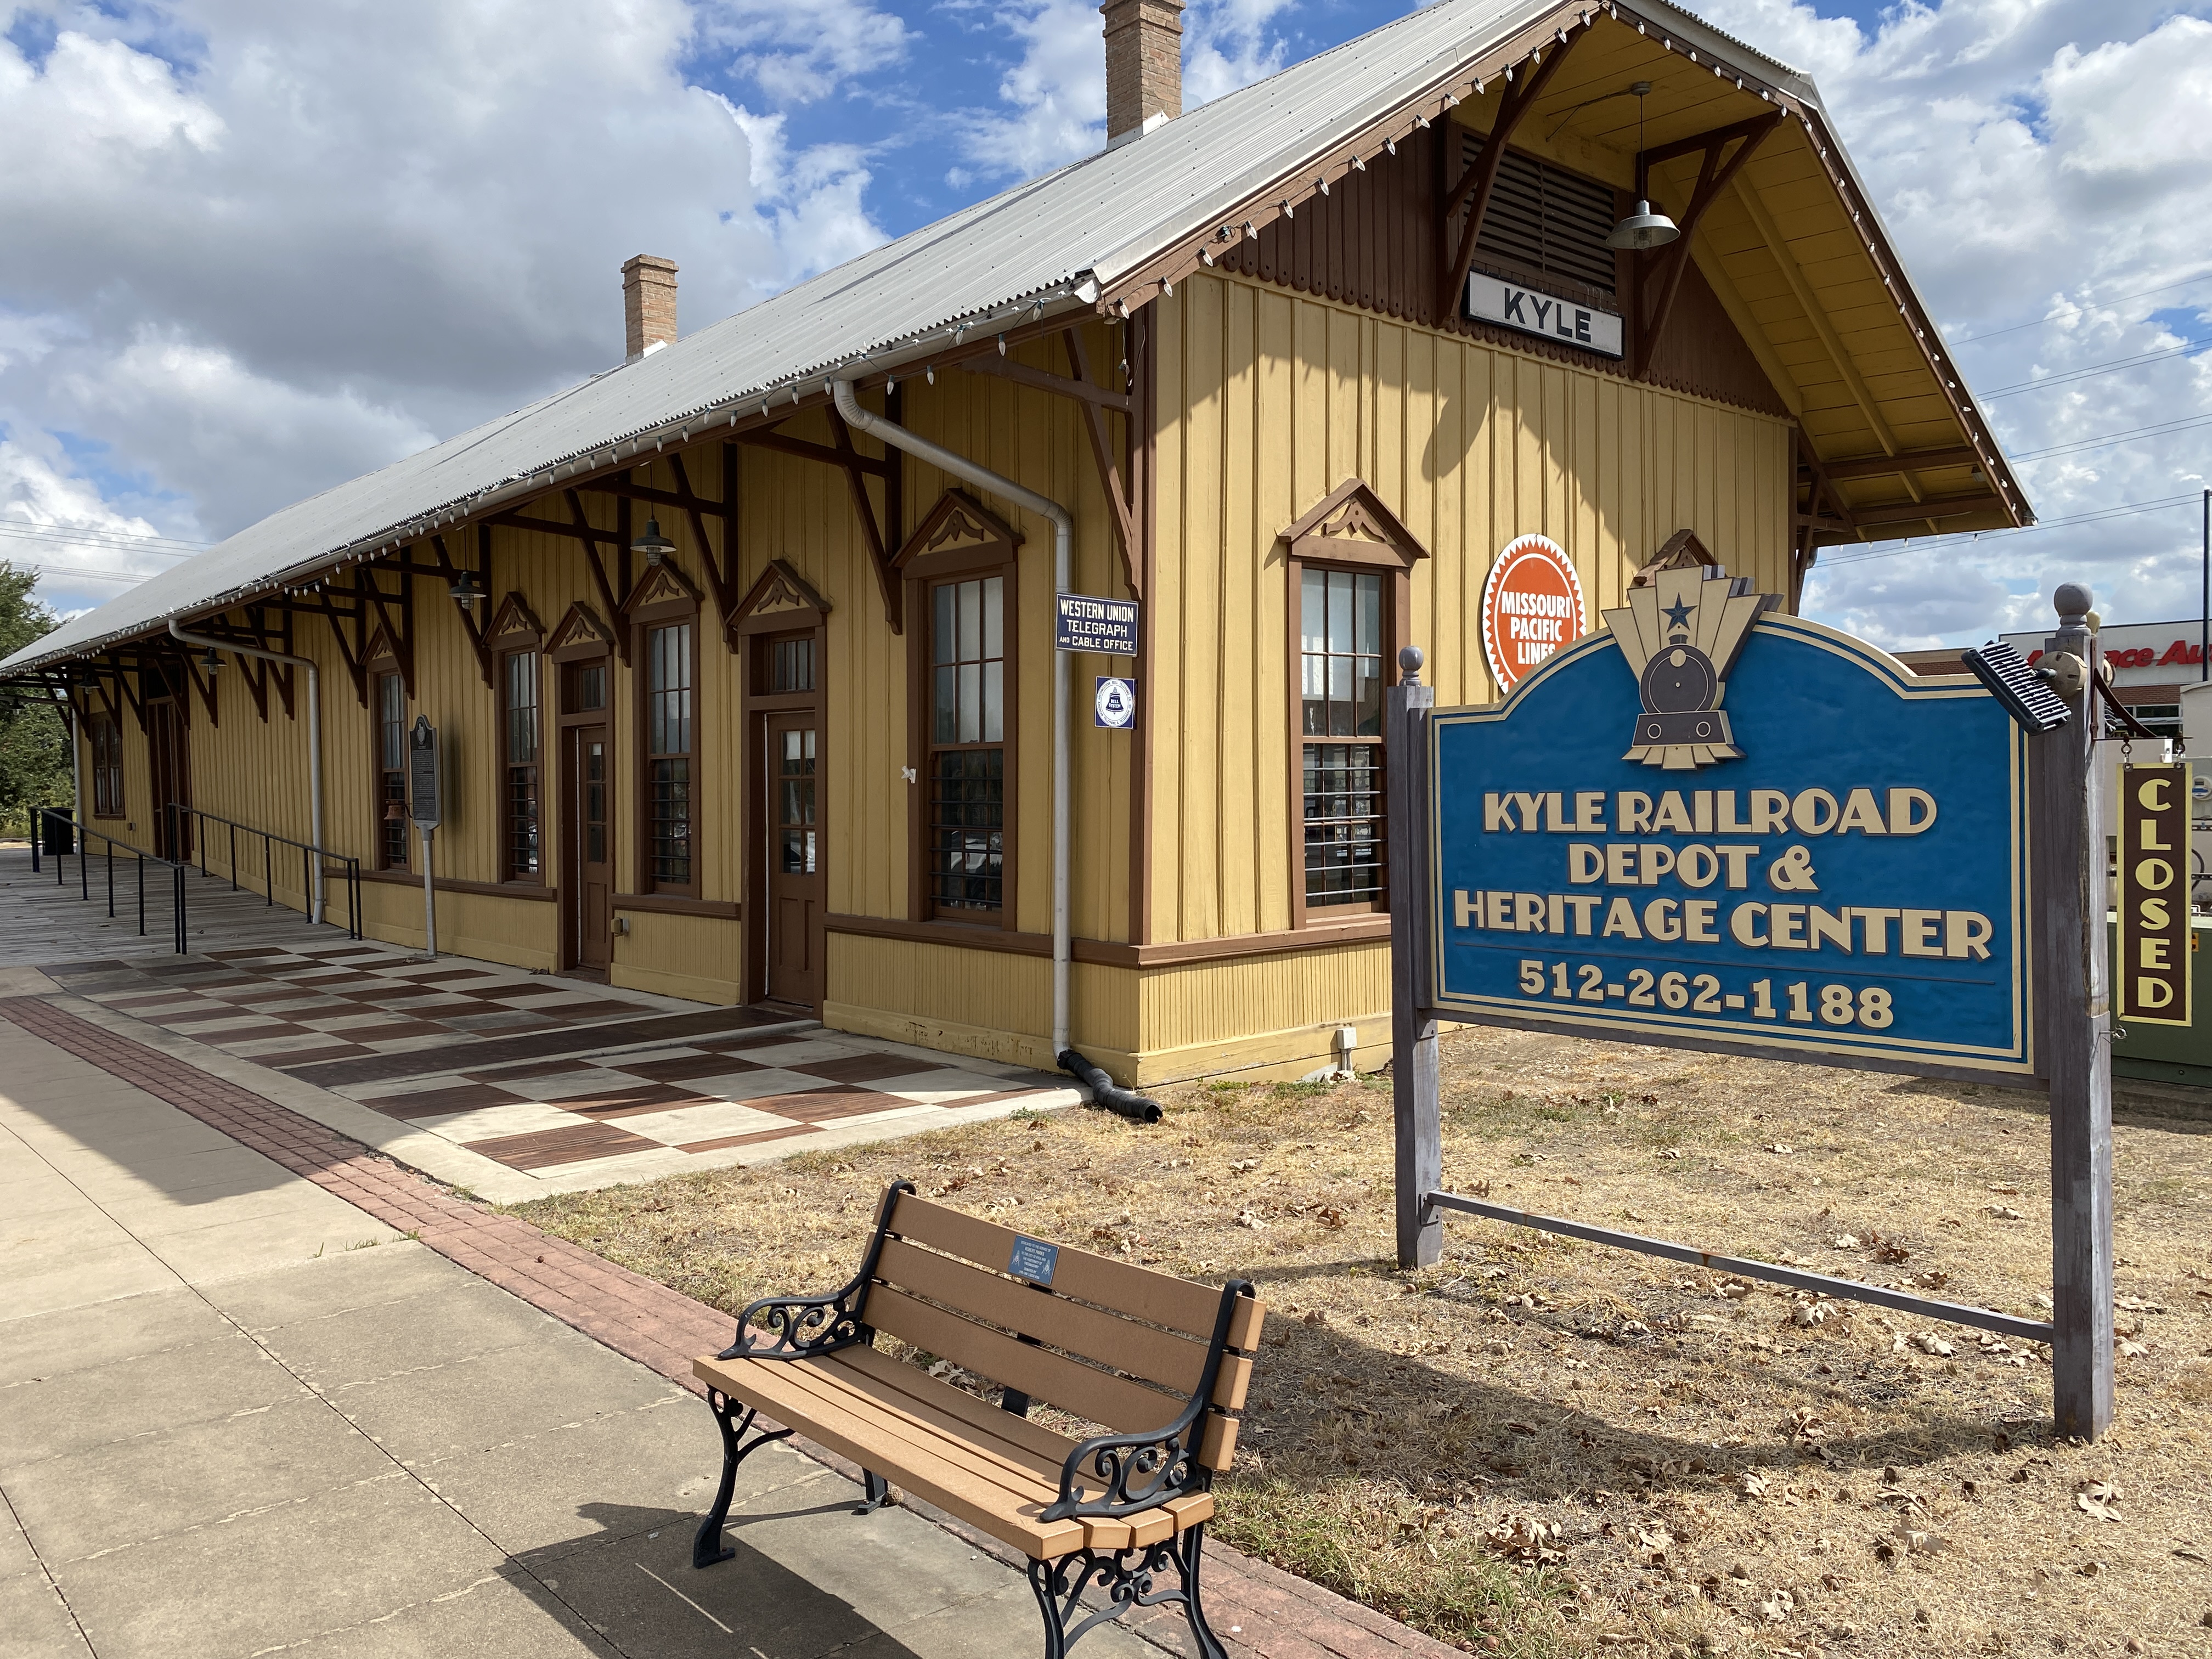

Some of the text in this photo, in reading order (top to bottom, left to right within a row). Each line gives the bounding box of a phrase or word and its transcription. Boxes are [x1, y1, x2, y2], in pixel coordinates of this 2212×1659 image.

[1505, 287, 1591, 343] KYLE
[1060, 599, 1134, 623] WESTERN UNION
[1066, 619, 1127, 637] TELEGRAPH
[1501, 591, 1570, 618] MISSOURI
[1072, 636, 1101, 648] CABLE
[1103, 639, 1133, 651] OFFICE
[1510, 617, 1562, 642] PACIFIC
[1483, 788, 1938, 836] KYLE RAILROAD
[1568, 844, 1820, 891] DEPOT &
[2135, 778, 2174, 1008] CLOSED
[1454, 889, 1993, 961] HERITAGE CENTER
[1519, 959, 1894, 1029] 512-262-1188
